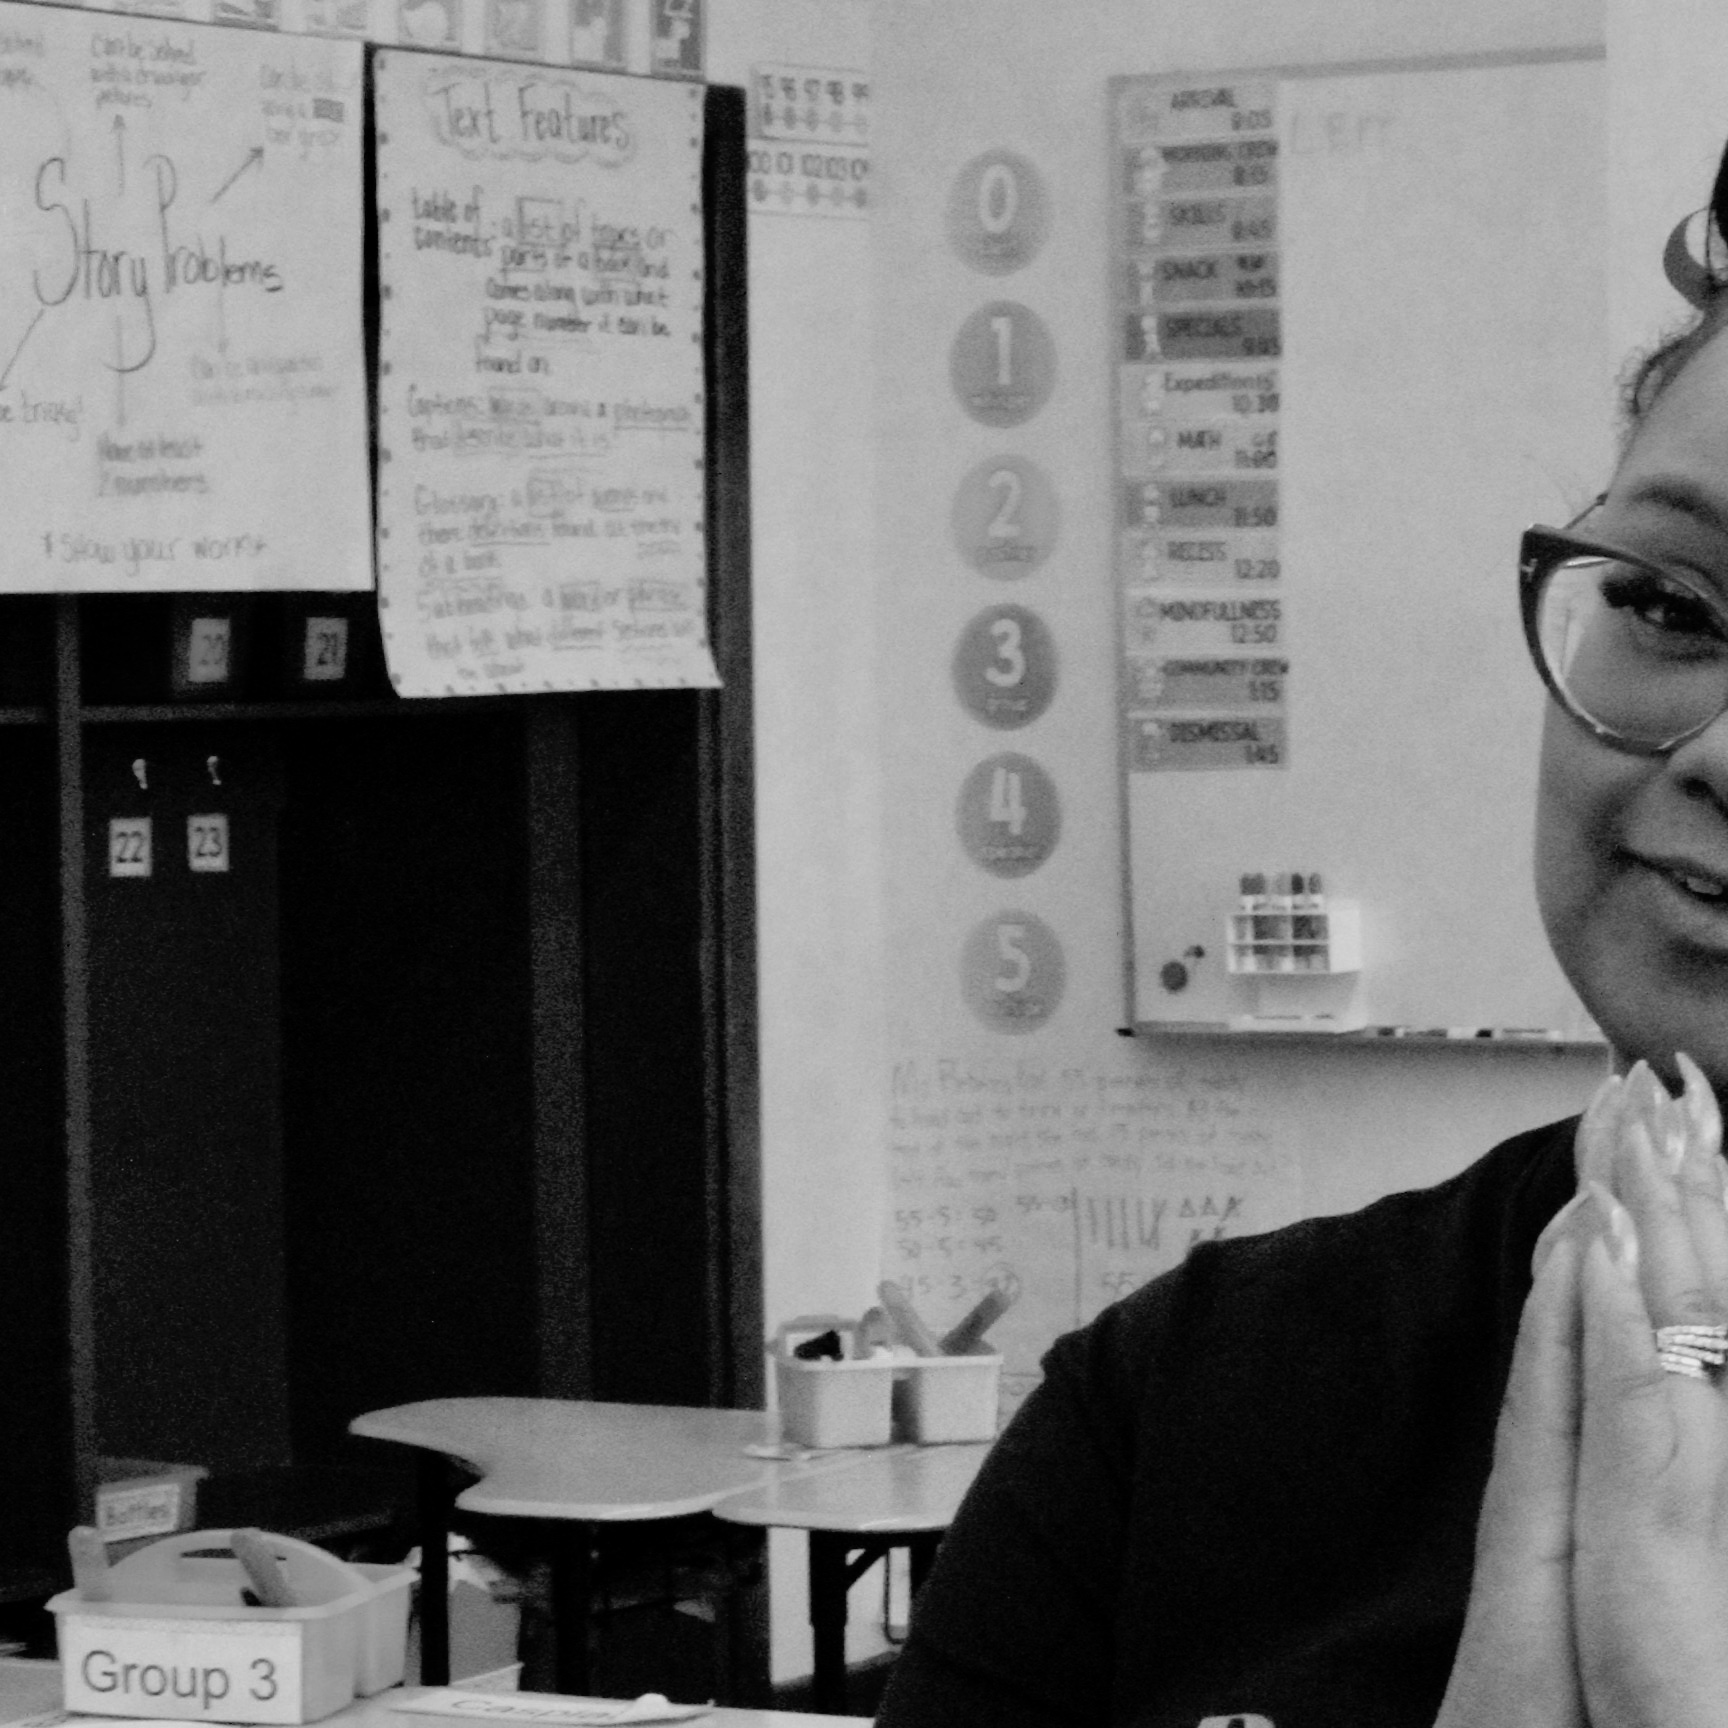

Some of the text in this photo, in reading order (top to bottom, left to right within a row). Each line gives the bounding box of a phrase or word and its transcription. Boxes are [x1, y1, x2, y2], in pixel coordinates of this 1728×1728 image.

[425, 80, 629, 150] Text Features
[979, 164, 1018, 234] 0
[33, 153, 285, 373] Story Problems
[991, 316, 1013, 386] 1
[1177, 430, 1222, 450] MATH
[987, 470, 1021, 538] 2
[1169, 485, 1228, 509] LUNCH
[1168, 540, 1228, 562] RECESS
[1234, 558, 1282, 580] 12:20
[1159, 598, 1282, 623] MINDFULLNESS
[1231, 622, 1278, 645] 12:50
[315, 627, 341, 668] 21
[986, 618, 1027, 687] 3
[989, 767, 1028, 835] 4
[115, 830, 146, 864] 22
[194, 826, 223, 859] 23
[995, 923, 1031, 992] 5
[81, 1648, 280, 1709] Group 3
